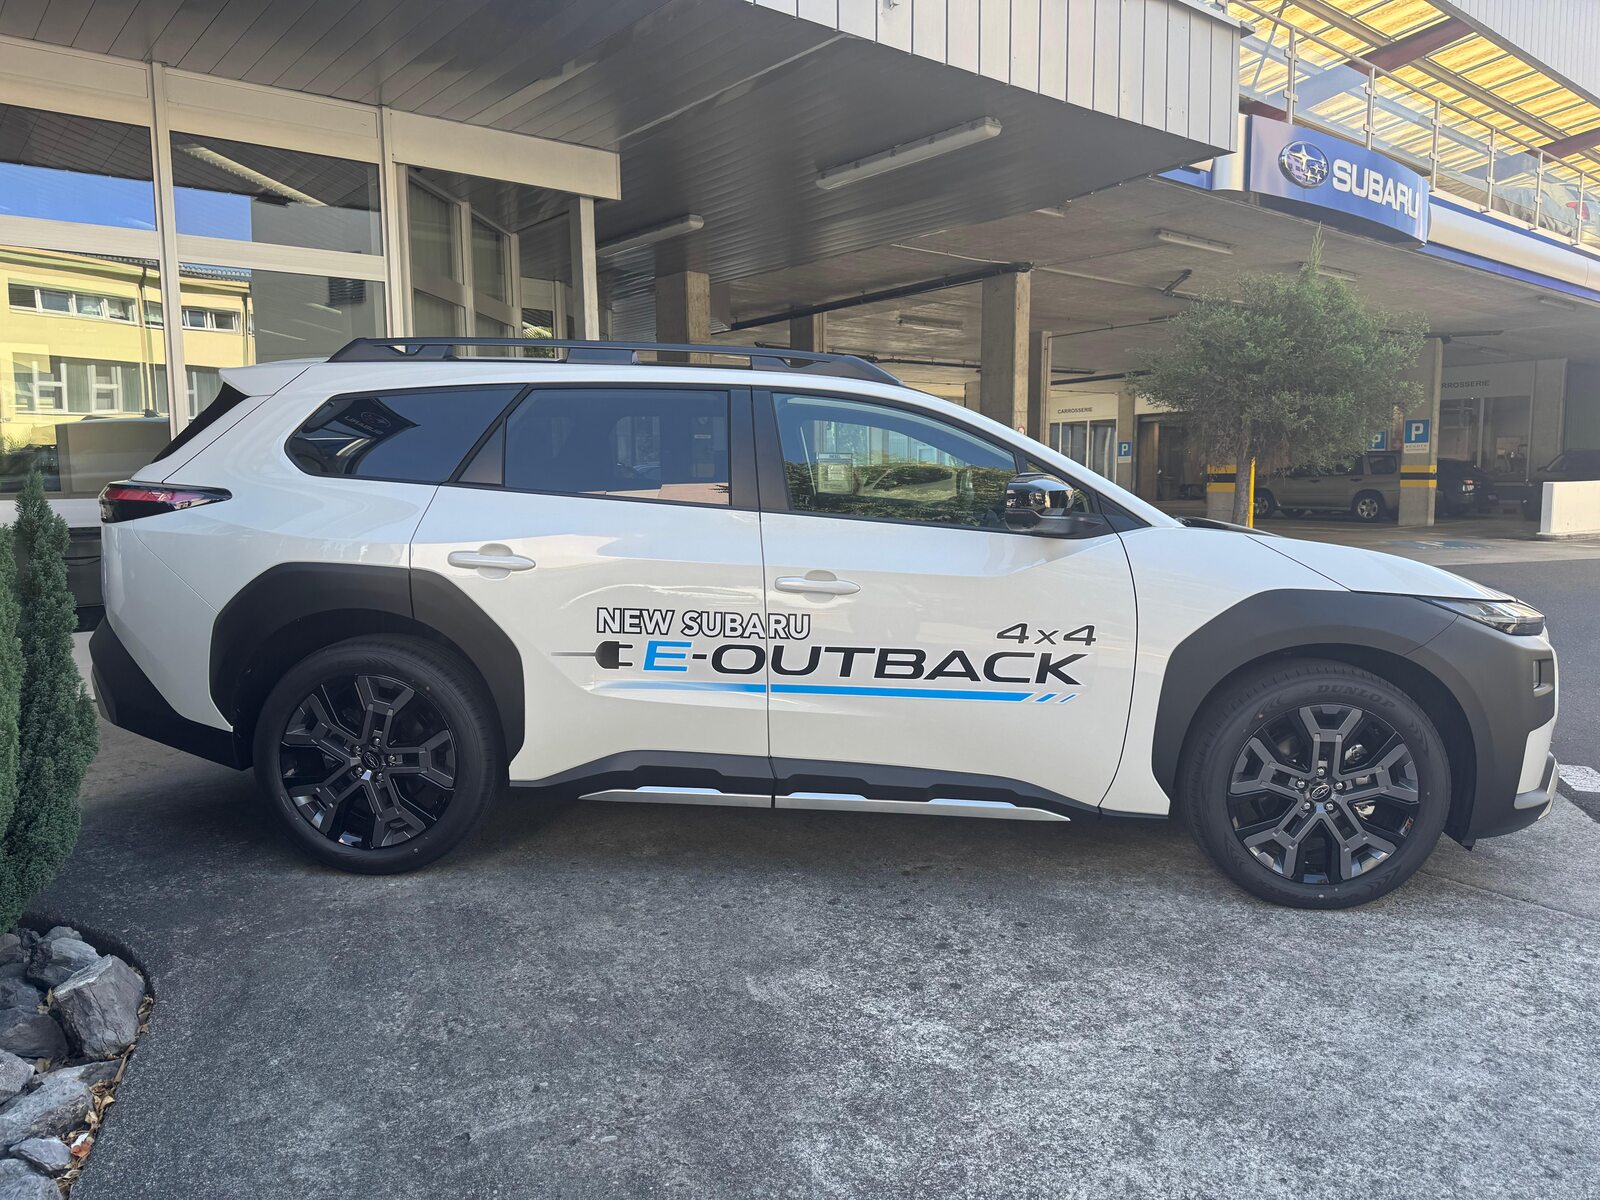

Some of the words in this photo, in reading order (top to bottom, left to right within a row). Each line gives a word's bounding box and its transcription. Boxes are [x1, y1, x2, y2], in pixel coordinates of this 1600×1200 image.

[1332, 159, 1419, 219] SUBARU
[1441, 380, 1490, 389] RROSSERIE
[1057, 406, 1093, 415] CARROSSERIE
[1411, 423, 1423, 441] P
[1121, 443, 1129, 455] P
[597, 607, 675, 635] NEW
[681, 609, 810, 640] SUBARU
[996, 623, 1097, 646] 4x4
[643, 640, 1088, 686] E-OUTBACK
[1316, 684, 1396, 708] DUNLOP
